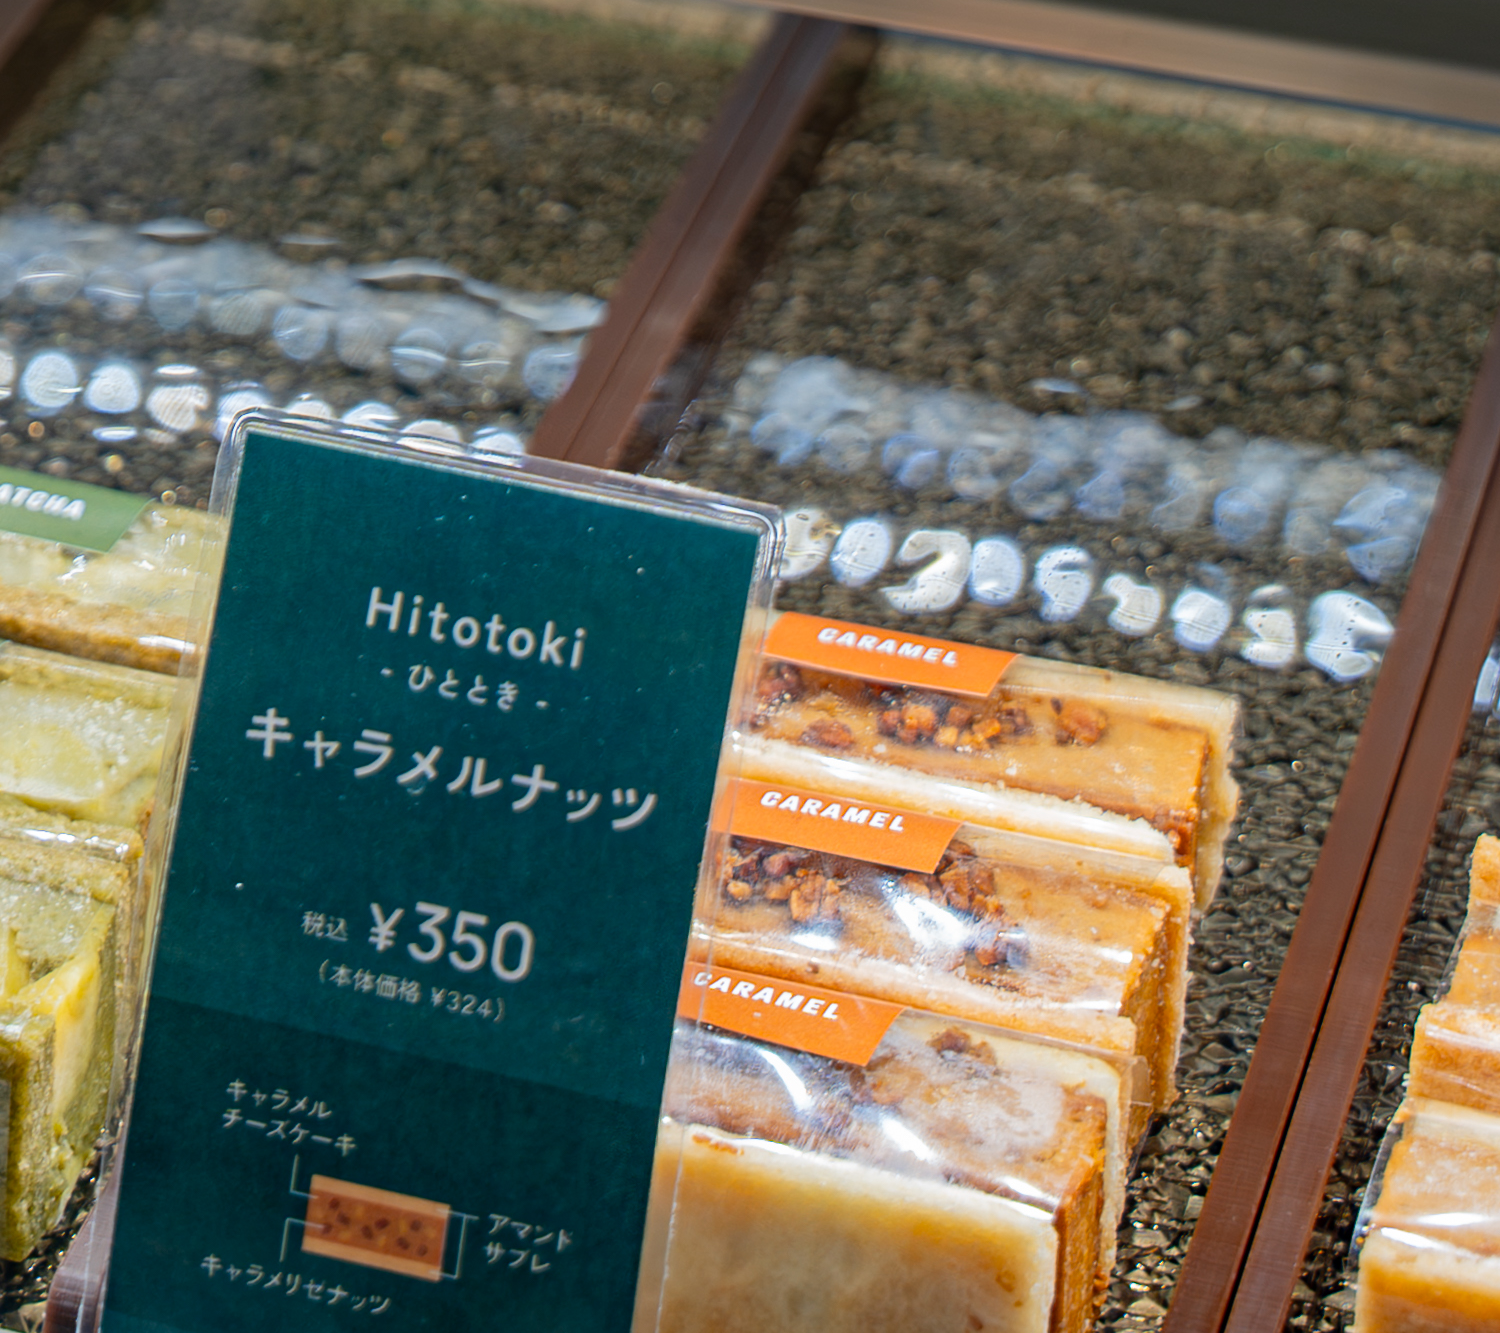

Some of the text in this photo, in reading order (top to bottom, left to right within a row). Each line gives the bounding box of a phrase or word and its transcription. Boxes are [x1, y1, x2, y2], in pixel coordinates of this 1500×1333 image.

[365, 586, 587, 670] Hitotoki
[817, 627, 959, 668] CARAMEL
[246, 707, 658, 831] キャラメルナッツ
[760, 790, 904, 832] CARAMEL
[301, 901, 536, 983] 税込 ¥350
[694, 972, 839, 1021] CARAMEL
[226, 1078, 333, 1119] キャラメル
[200, 1253, 392, 1314] キャラメリゼナッツ
